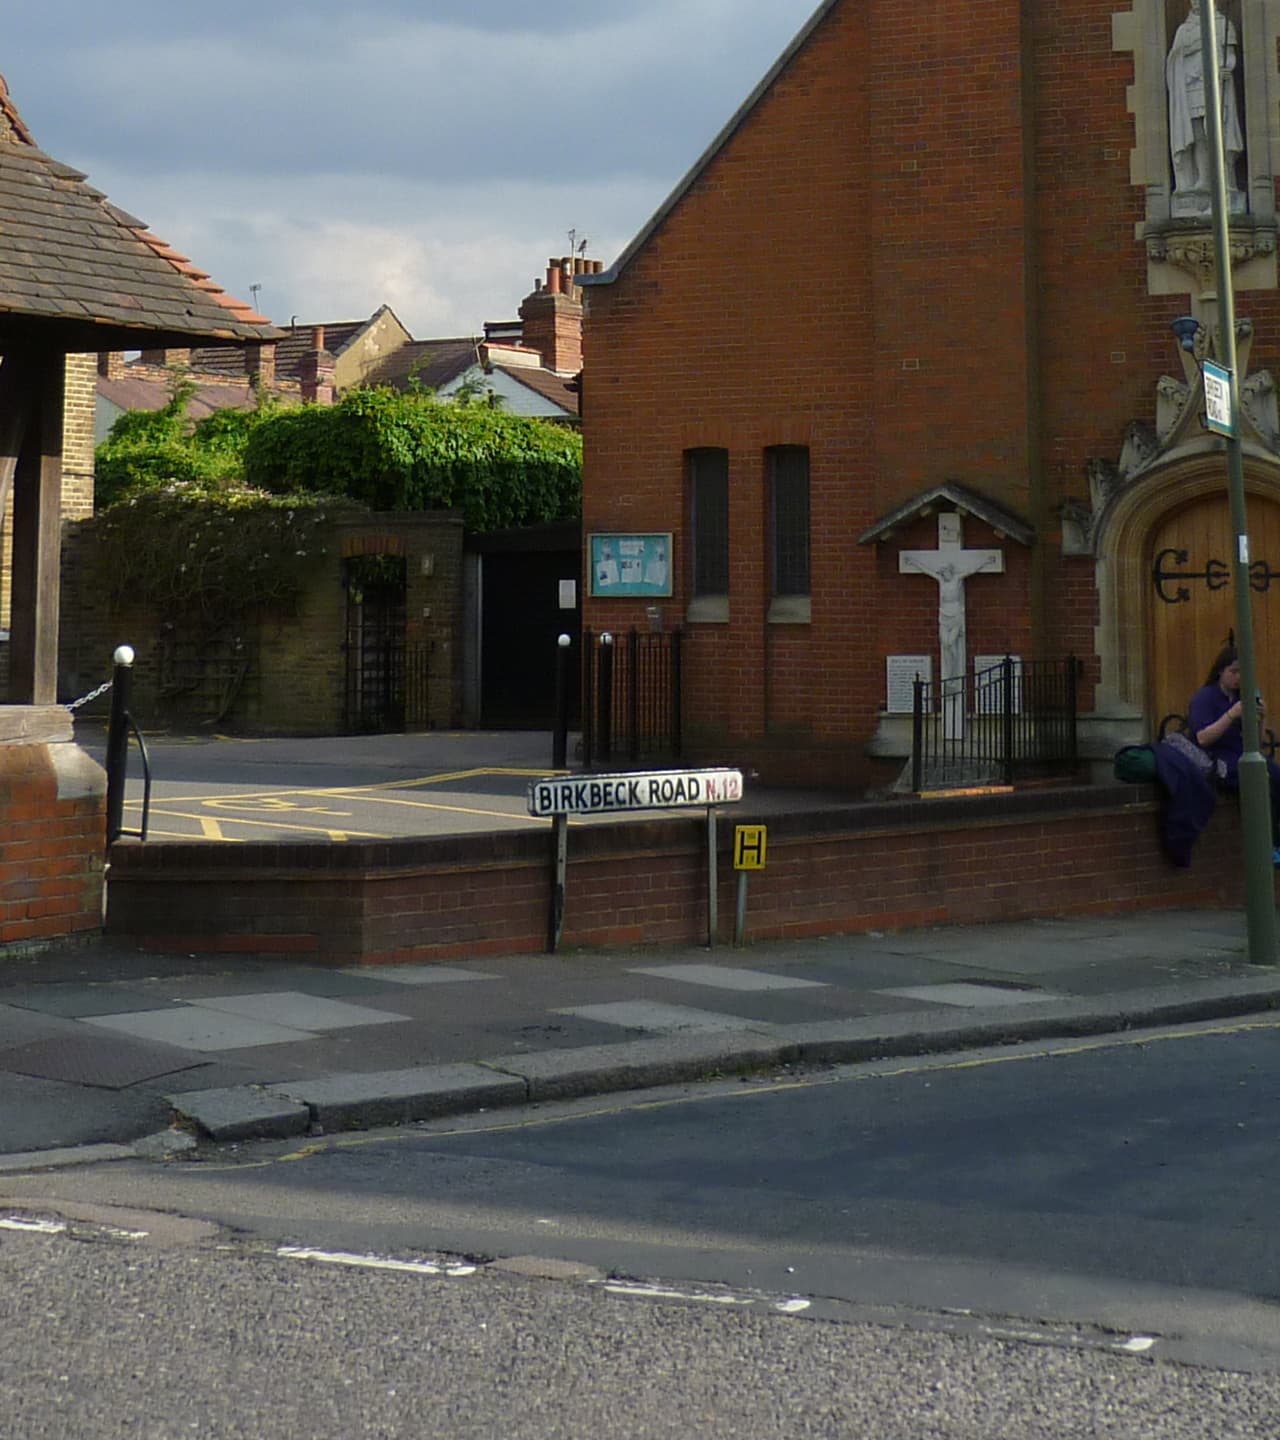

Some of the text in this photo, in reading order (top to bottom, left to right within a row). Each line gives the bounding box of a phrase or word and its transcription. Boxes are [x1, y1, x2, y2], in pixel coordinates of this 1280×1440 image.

[539, 777, 740, 811] BIRKBECK ROAD N.12
[739, 830, 762, 865] H
